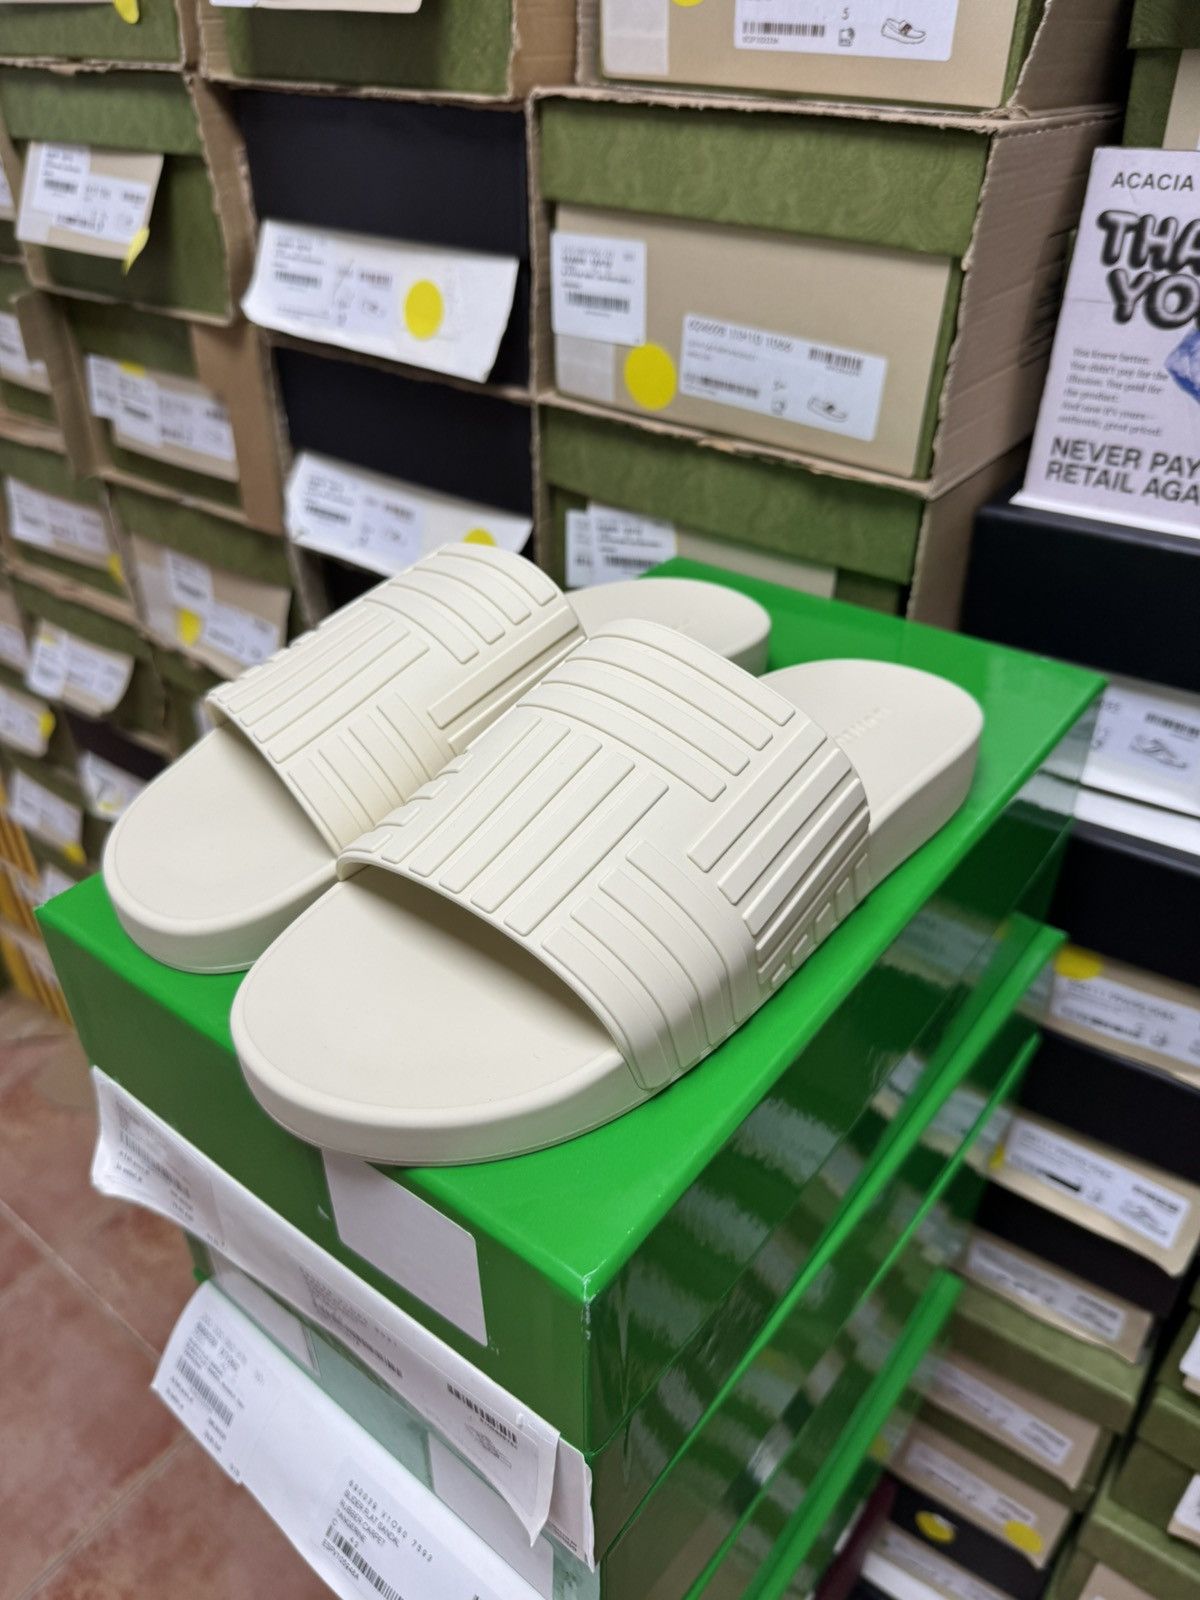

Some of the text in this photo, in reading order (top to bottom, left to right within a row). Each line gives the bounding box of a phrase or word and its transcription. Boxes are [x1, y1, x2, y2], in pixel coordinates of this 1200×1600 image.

[1111, 172, 1194, 191] ACACIA
[1106, 268, 1200, 331] YO
[1050, 436, 1200, 479] NEVER PAY
[1045, 460, 1200, 506] RETAIL AGA
